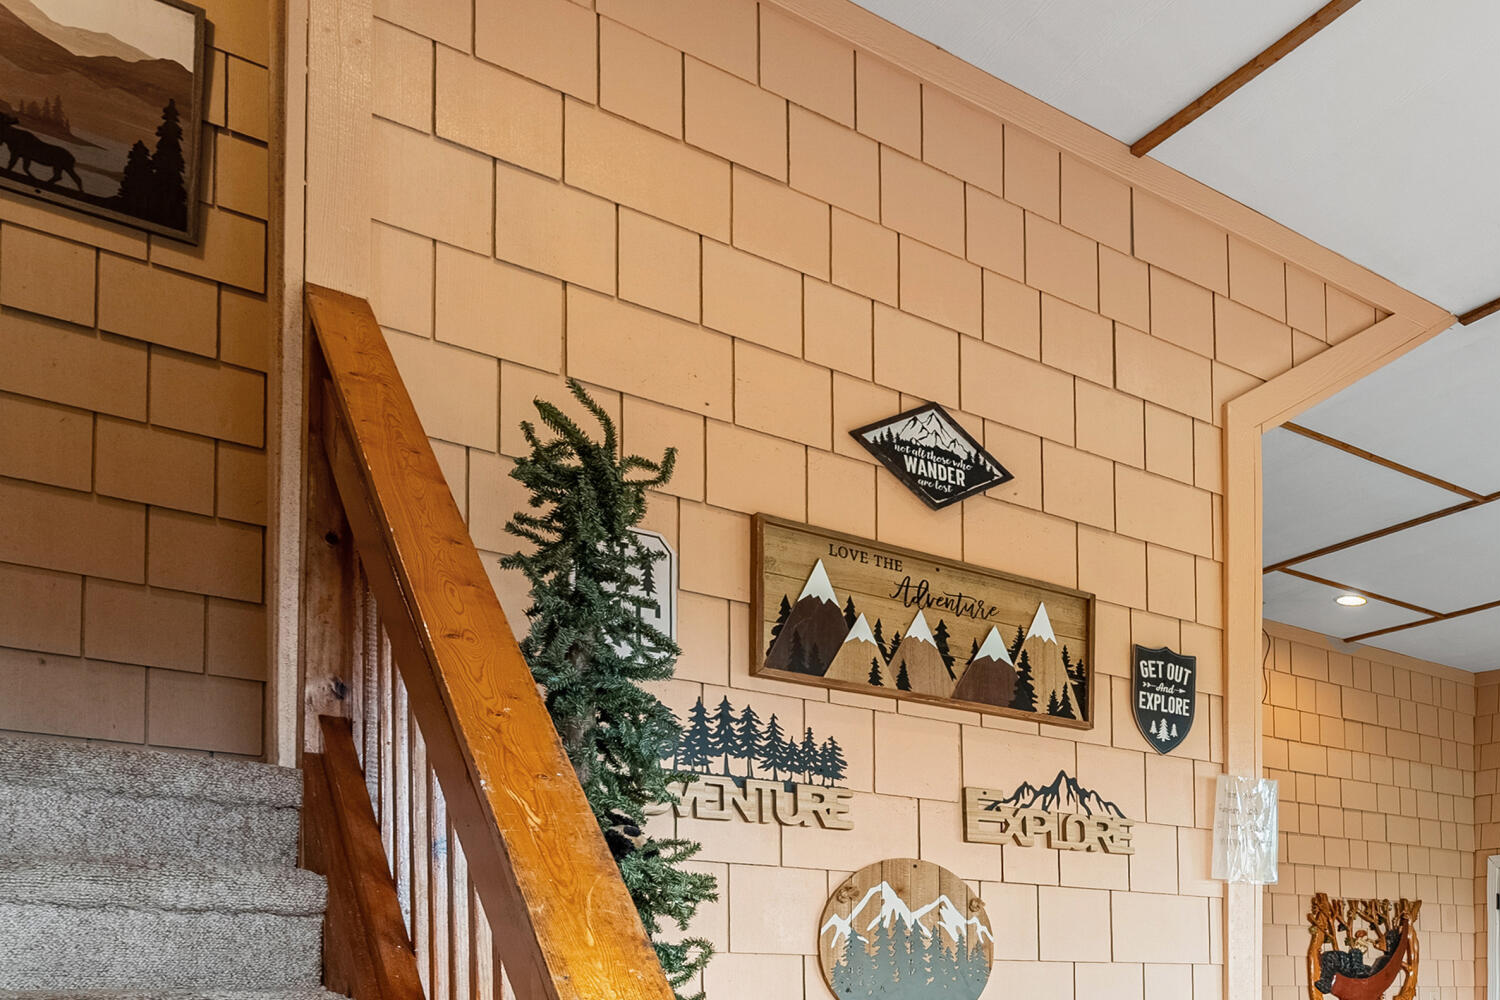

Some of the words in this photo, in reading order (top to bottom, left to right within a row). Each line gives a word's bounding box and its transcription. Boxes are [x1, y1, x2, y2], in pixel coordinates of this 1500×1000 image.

[894, 444, 911, 455] not
[912, 447, 927, 459] all
[926, 450, 951, 465] those
[951, 459, 973, 472] who
[903, 454, 966, 487] WANDER
[917, 478, 935, 489] are
[935, 480, 953, 493] lost
[828, 544, 869, 565] LOVE
[873, 554, 903, 573] THE
[889, 575, 1000, 620] Adventure
[1139, 660, 1164, 679] GET
[1166, 662, 1192, 686] OUT
[1156, 682, 1175, 694] And
[1139, 691, 1190, 717] EXPLORE
[962, 786, 1136, 856] EXPLORE
